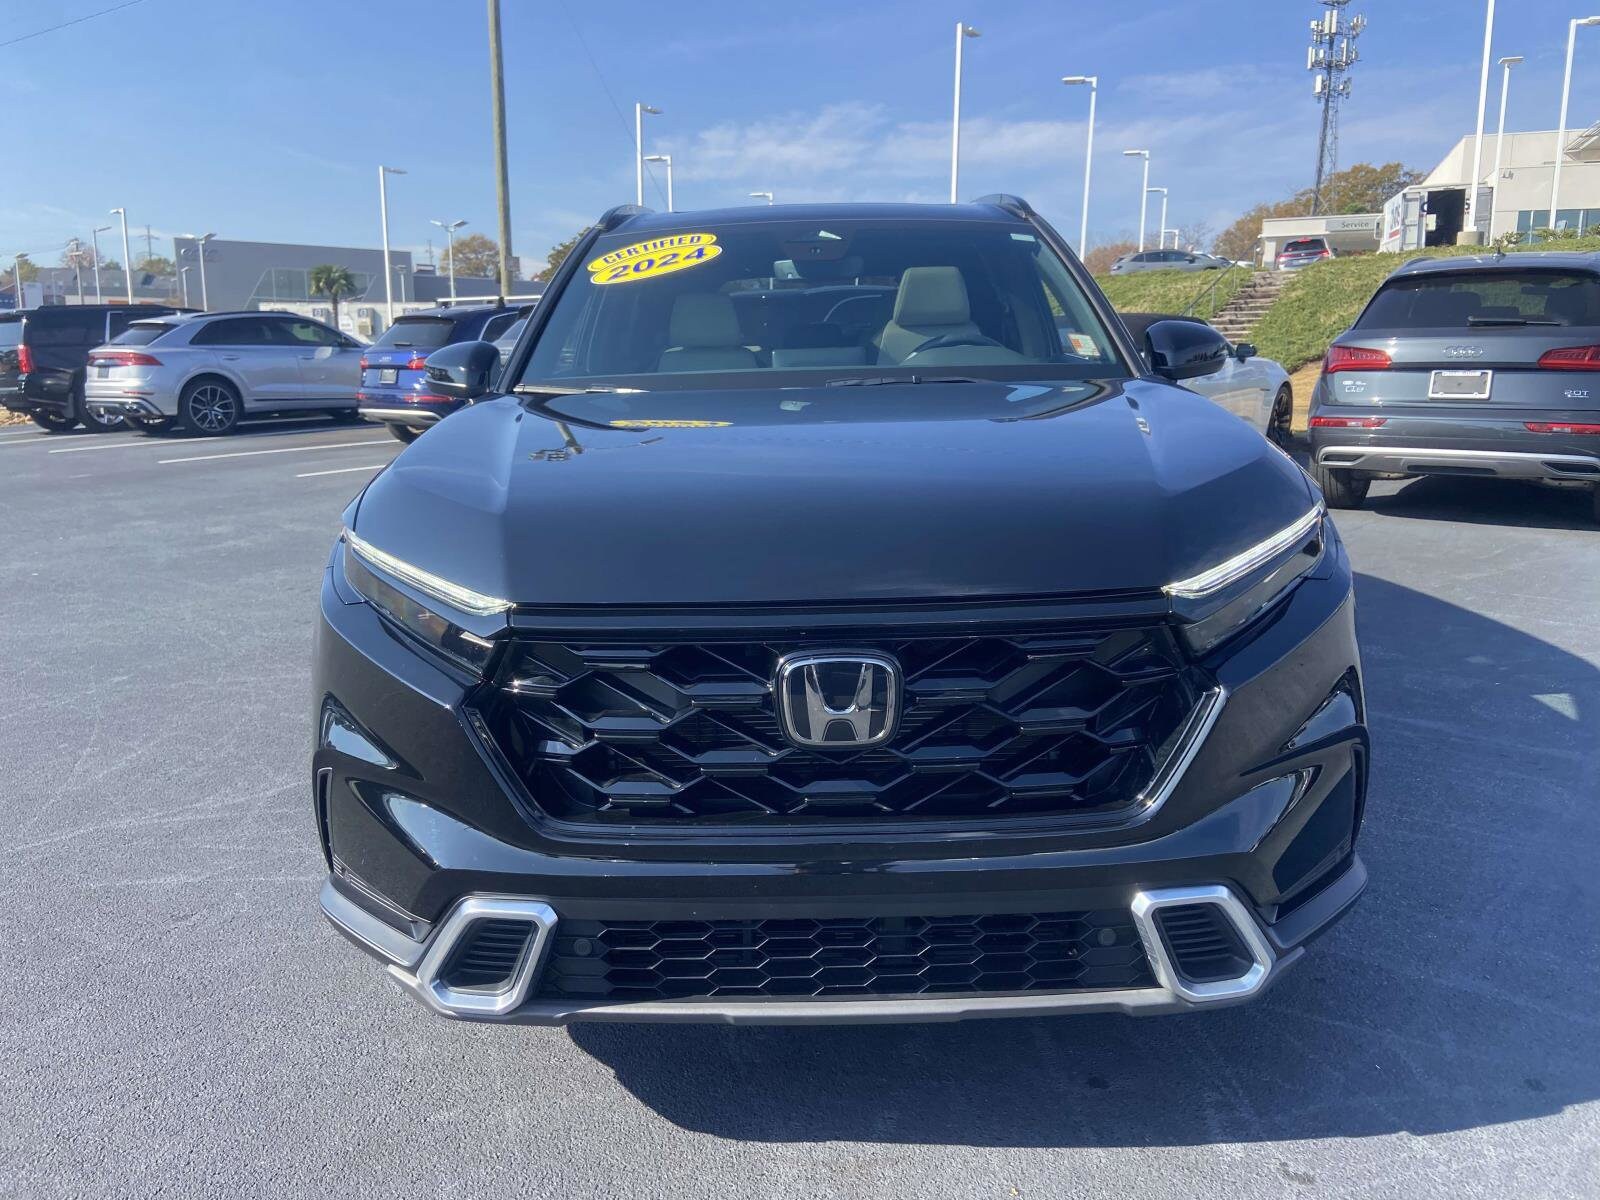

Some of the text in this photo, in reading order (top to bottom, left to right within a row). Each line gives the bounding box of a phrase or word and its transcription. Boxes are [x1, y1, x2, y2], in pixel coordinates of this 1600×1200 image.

[1341, 221, 1369, 229] Service
[603, 235, 702, 265] CERTIFIED
[606, 247, 706, 281] 2024
